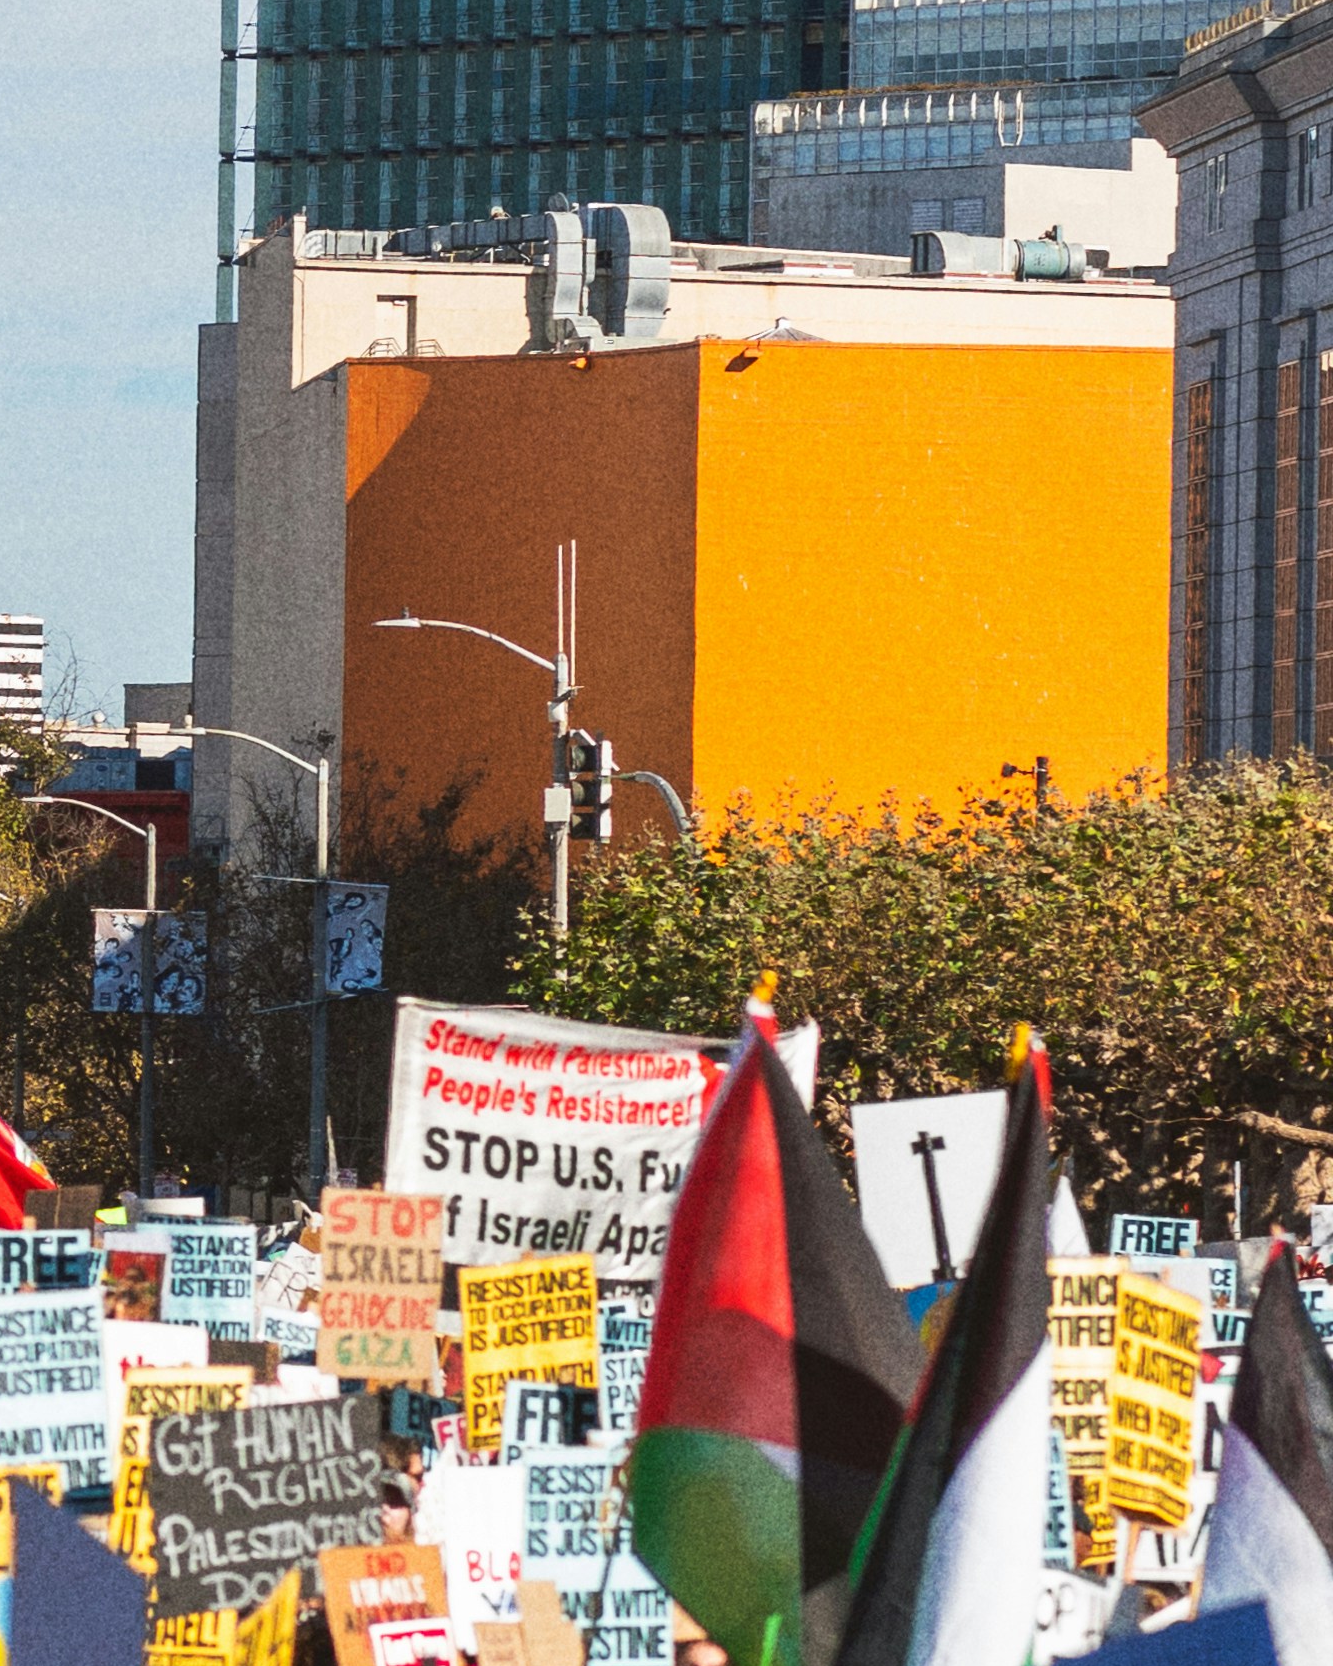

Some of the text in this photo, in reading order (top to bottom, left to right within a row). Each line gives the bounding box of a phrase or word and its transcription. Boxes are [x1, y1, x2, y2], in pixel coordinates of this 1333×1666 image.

[425, 1019, 691, 1080] Stand with Palestinian
[424, 1067, 694, 1127] People's Resistance!
[423, 1127, 538, 1183] STOP
[553, 1144, 623, 1193] U.S.
[328, 1195, 443, 1237] STOP
[446, 1195, 462, 1237] f
[478, 1199, 591, 1253] Israeli
[171, 1236, 250, 1256] ISTANCE
[1120, 1220, 1190, 1255] FREE
[171, 1259, 251, 1275] CCUPATION
[325, 1242, 443, 1284] ISRAELI
[171, 1278, 251, 1298] USTIFIED!
[465, 1267, 590, 1304] RESISTANCE
[321, 1292, 437, 1332] GENOCIDE
[469, 1308, 487, 1326] TO
[493, 1294, 591, 1321] OCCUPATION
[206, 1320, 250, 1342] WITH
[470, 1318, 593, 1351] IS JUSTIFIED!
[335, 1333, 415, 1367] GAZA
[605, 1358, 644, 1382] STA
[127, 1384, 243, 1417] RESISTANCE
[50, 1424, 106, 1452] WITH
[233, 1397, 357, 1469] HUMAN
[203, 1450, 382, 1515] RIGHTS?
[529, 1465, 605, 1495] RESIST
[529, 1501, 549, 1522] TO
[157, 1507, 384, 1577] PALESTINIANS
[527, 1529, 548, 1557] IS
[613, 1589, 667, 1618] WITH
[590, 1625, 666, 1659] STINE
